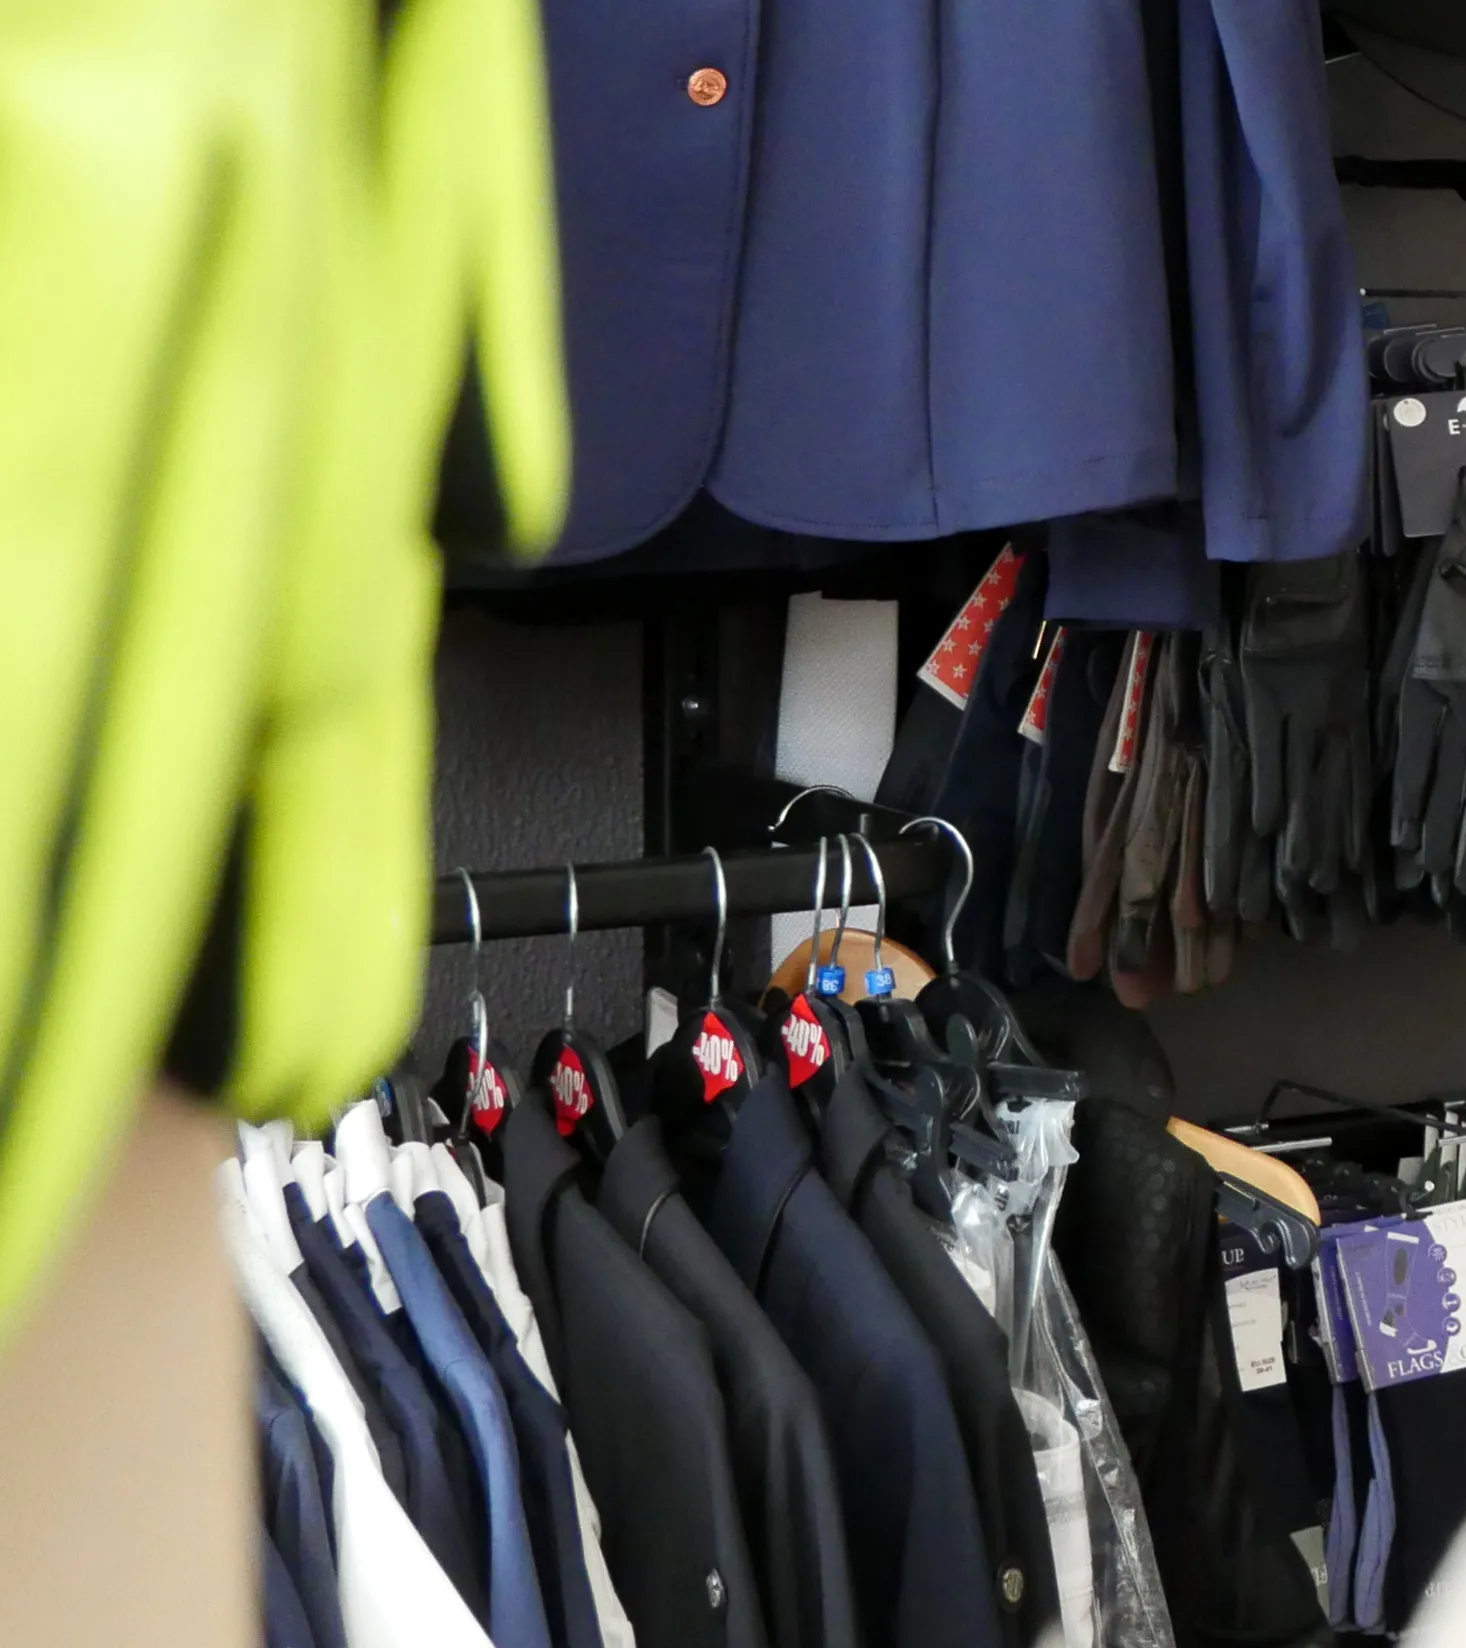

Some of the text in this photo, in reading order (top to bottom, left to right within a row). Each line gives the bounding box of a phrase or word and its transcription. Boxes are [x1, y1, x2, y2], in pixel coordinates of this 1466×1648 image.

[692, 1031, 738, 1083] -40%
[781, 1013, 826, 1067] -40%
[551, 1065, 589, 1115] -40%
